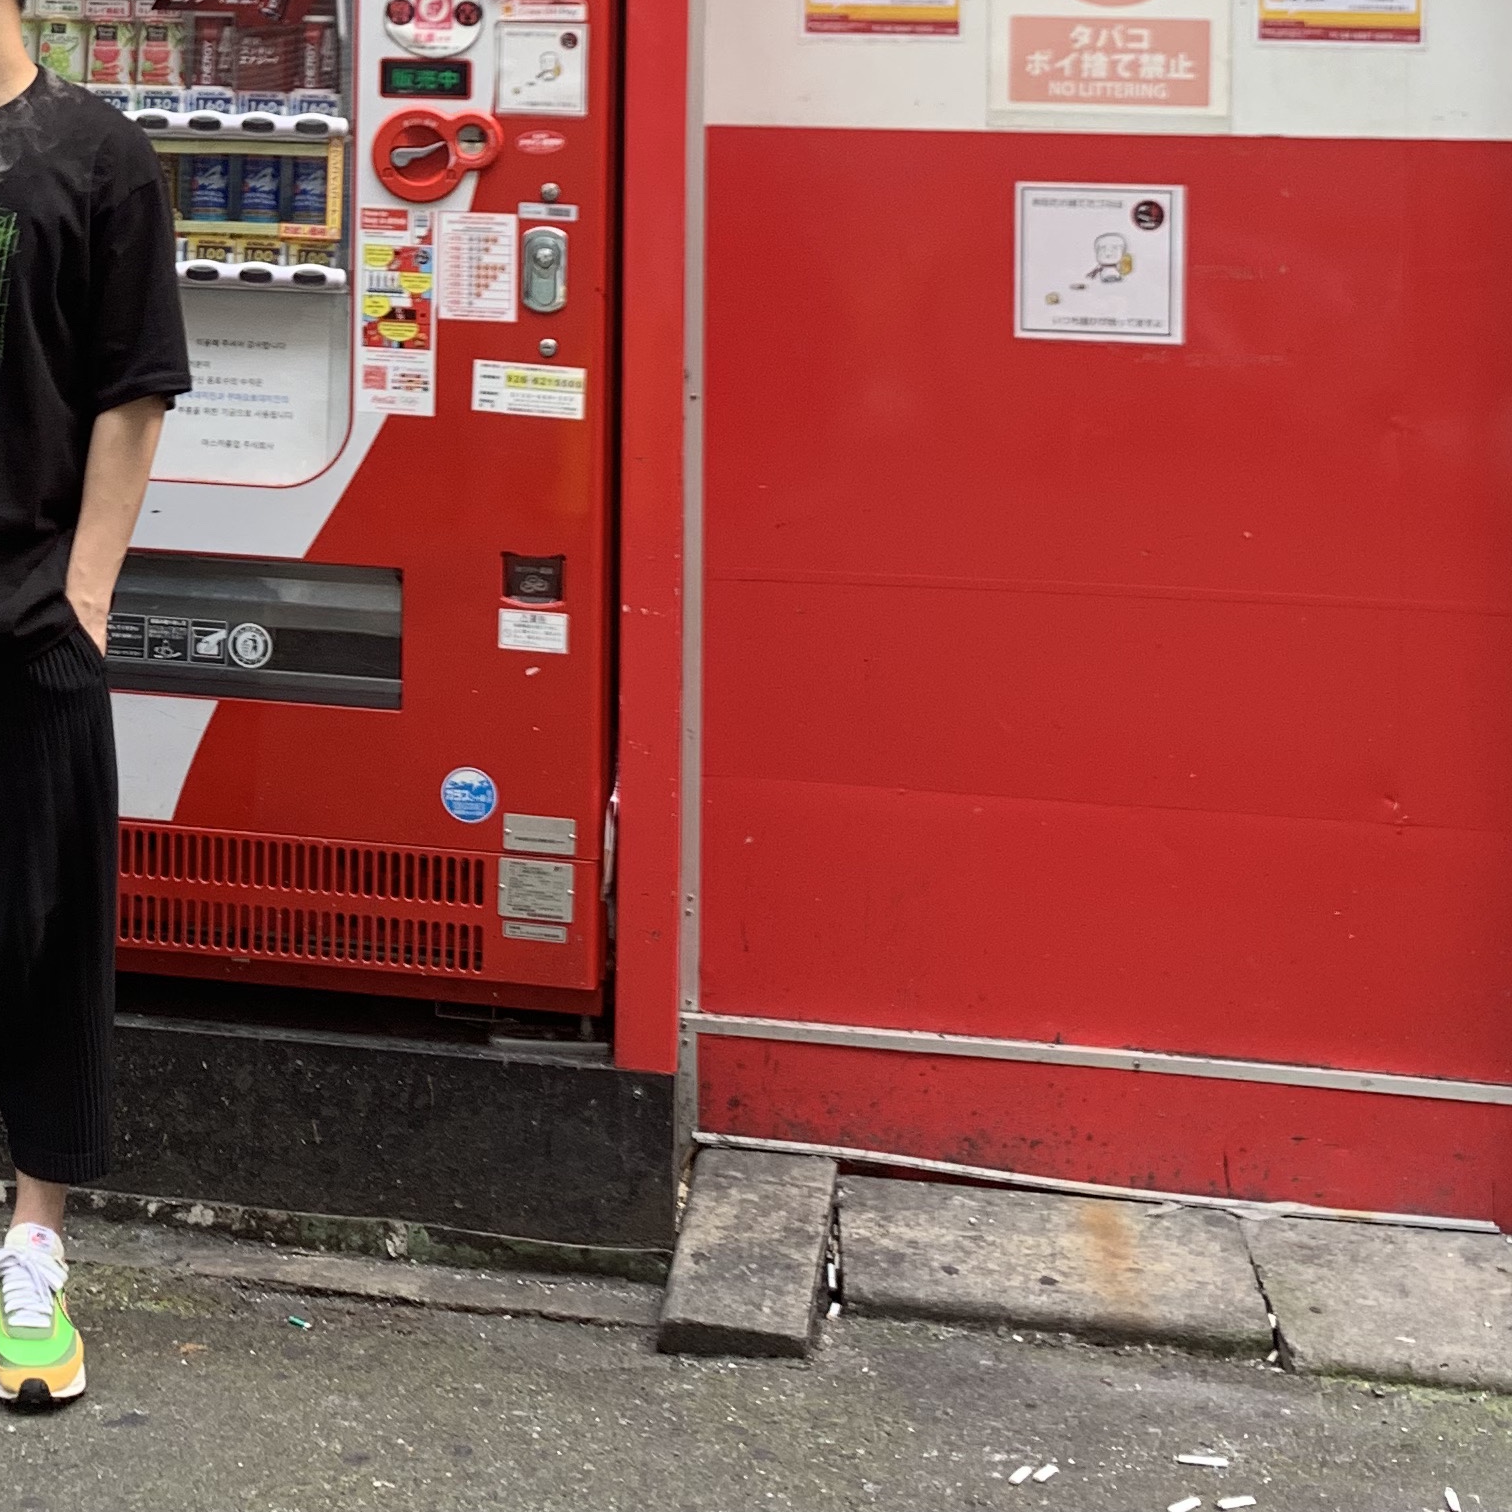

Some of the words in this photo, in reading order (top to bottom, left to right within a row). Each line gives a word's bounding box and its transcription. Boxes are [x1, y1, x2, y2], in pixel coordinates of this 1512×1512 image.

[1069, 23, 1152, 50] タバコ
[1048, 80, 1076, 97] NO
[1079, 81, 1169, 99] LITTERING
